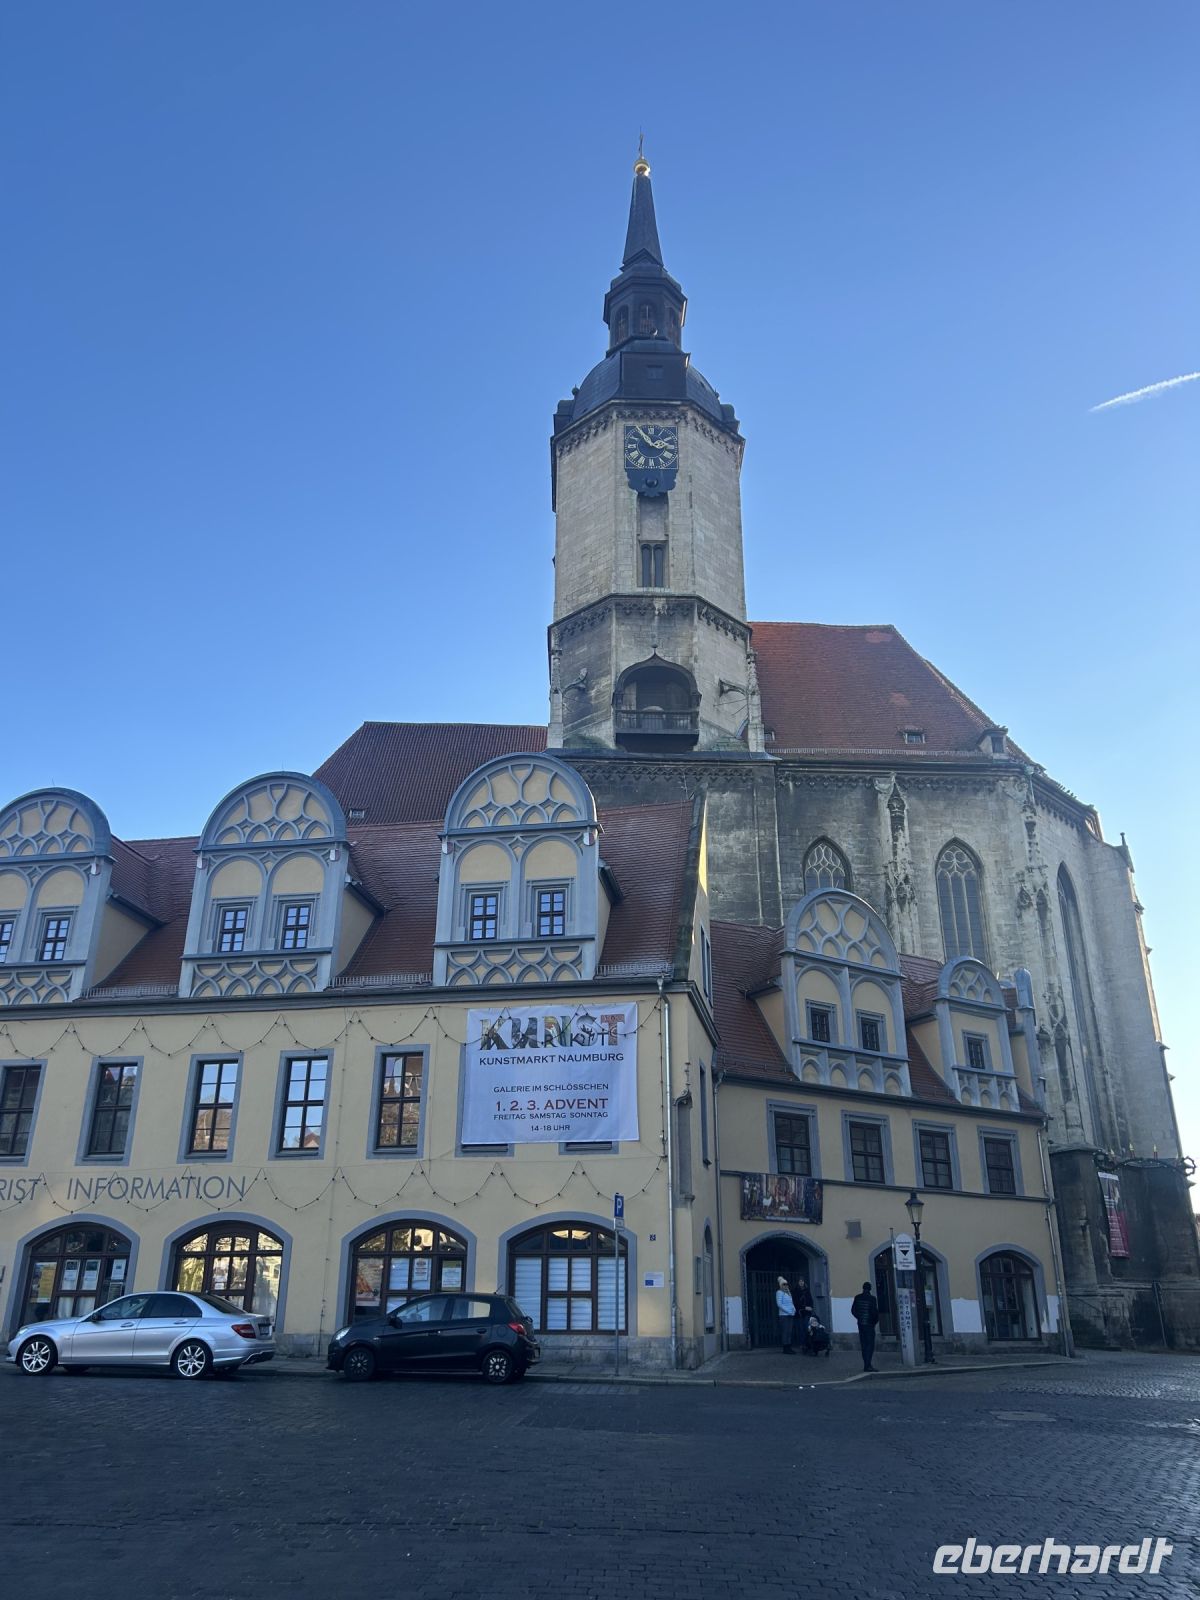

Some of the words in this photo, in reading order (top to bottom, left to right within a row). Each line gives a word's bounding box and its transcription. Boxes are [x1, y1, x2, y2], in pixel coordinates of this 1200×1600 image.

[480, 1014, 625, 1050] KUNST
[480, 1055, 555, 1066] KUNSTMARKT
[559, 1053, 624, 1063] NAUMBURG
[493, 1085, 531, 1093] GALERIE
[543, 1083, 609, 1091] SCHLÖSSCHEN
[496, 1101, 506, 1111] 1.
[510, 1100, 523, 1111] 2.
[527, 1100, 540, 1110] 3.
[544, 1098, 608, 1110] ADVENT
[67, 1176, 246, 1201] INFORMATION
[616, 1197, 623, 1215] P
